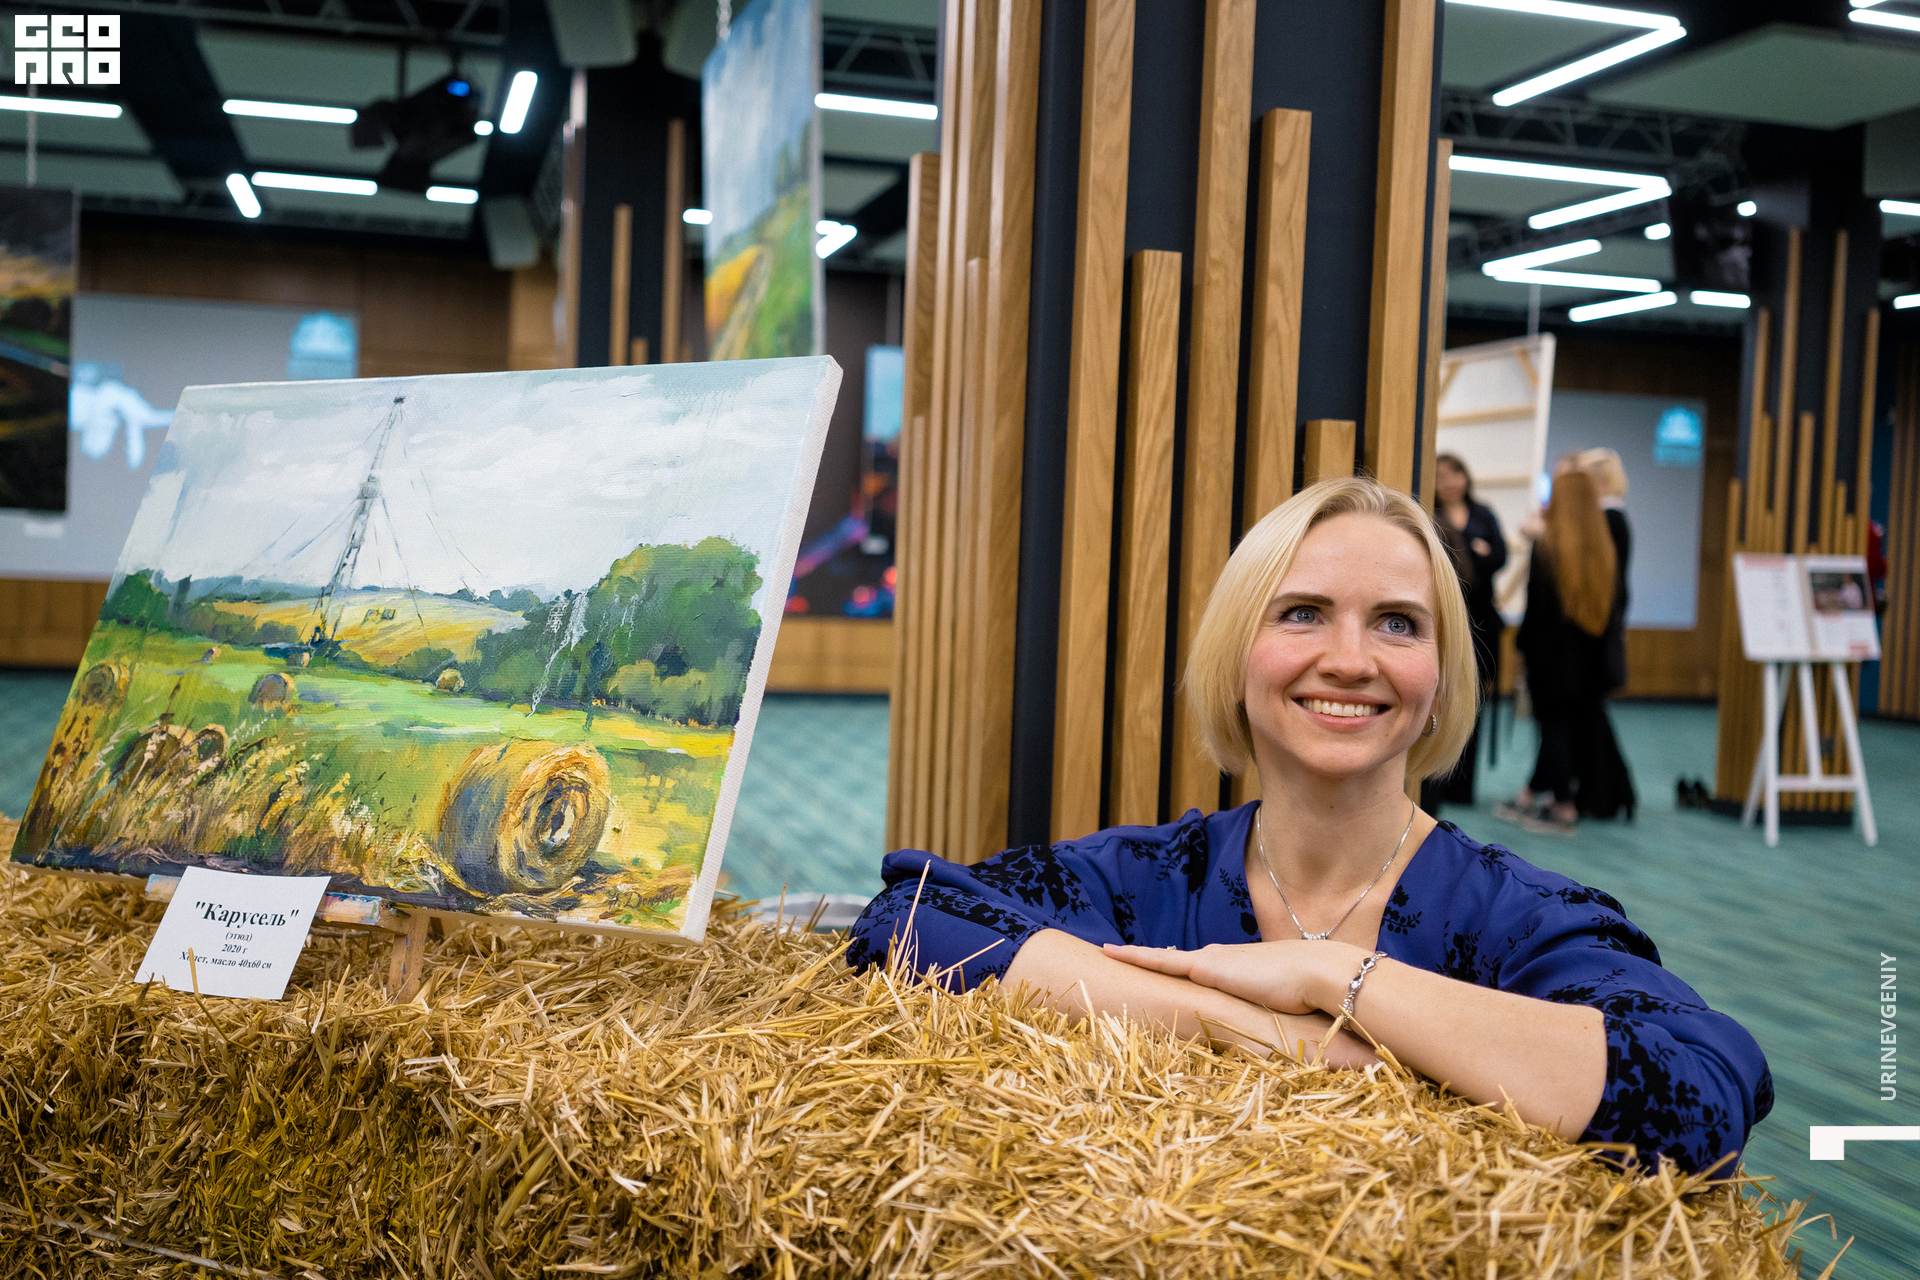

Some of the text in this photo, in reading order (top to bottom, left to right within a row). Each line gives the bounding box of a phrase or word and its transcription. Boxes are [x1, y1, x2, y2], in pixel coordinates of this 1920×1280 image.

[194, 901, 300, 929] "Карусель"
[225, 931, 253, 942] (этюд)
[221, 943, 242, 954] 2020
[210, 957, 237, 967] масло
[261, 961, 273, 970] см
